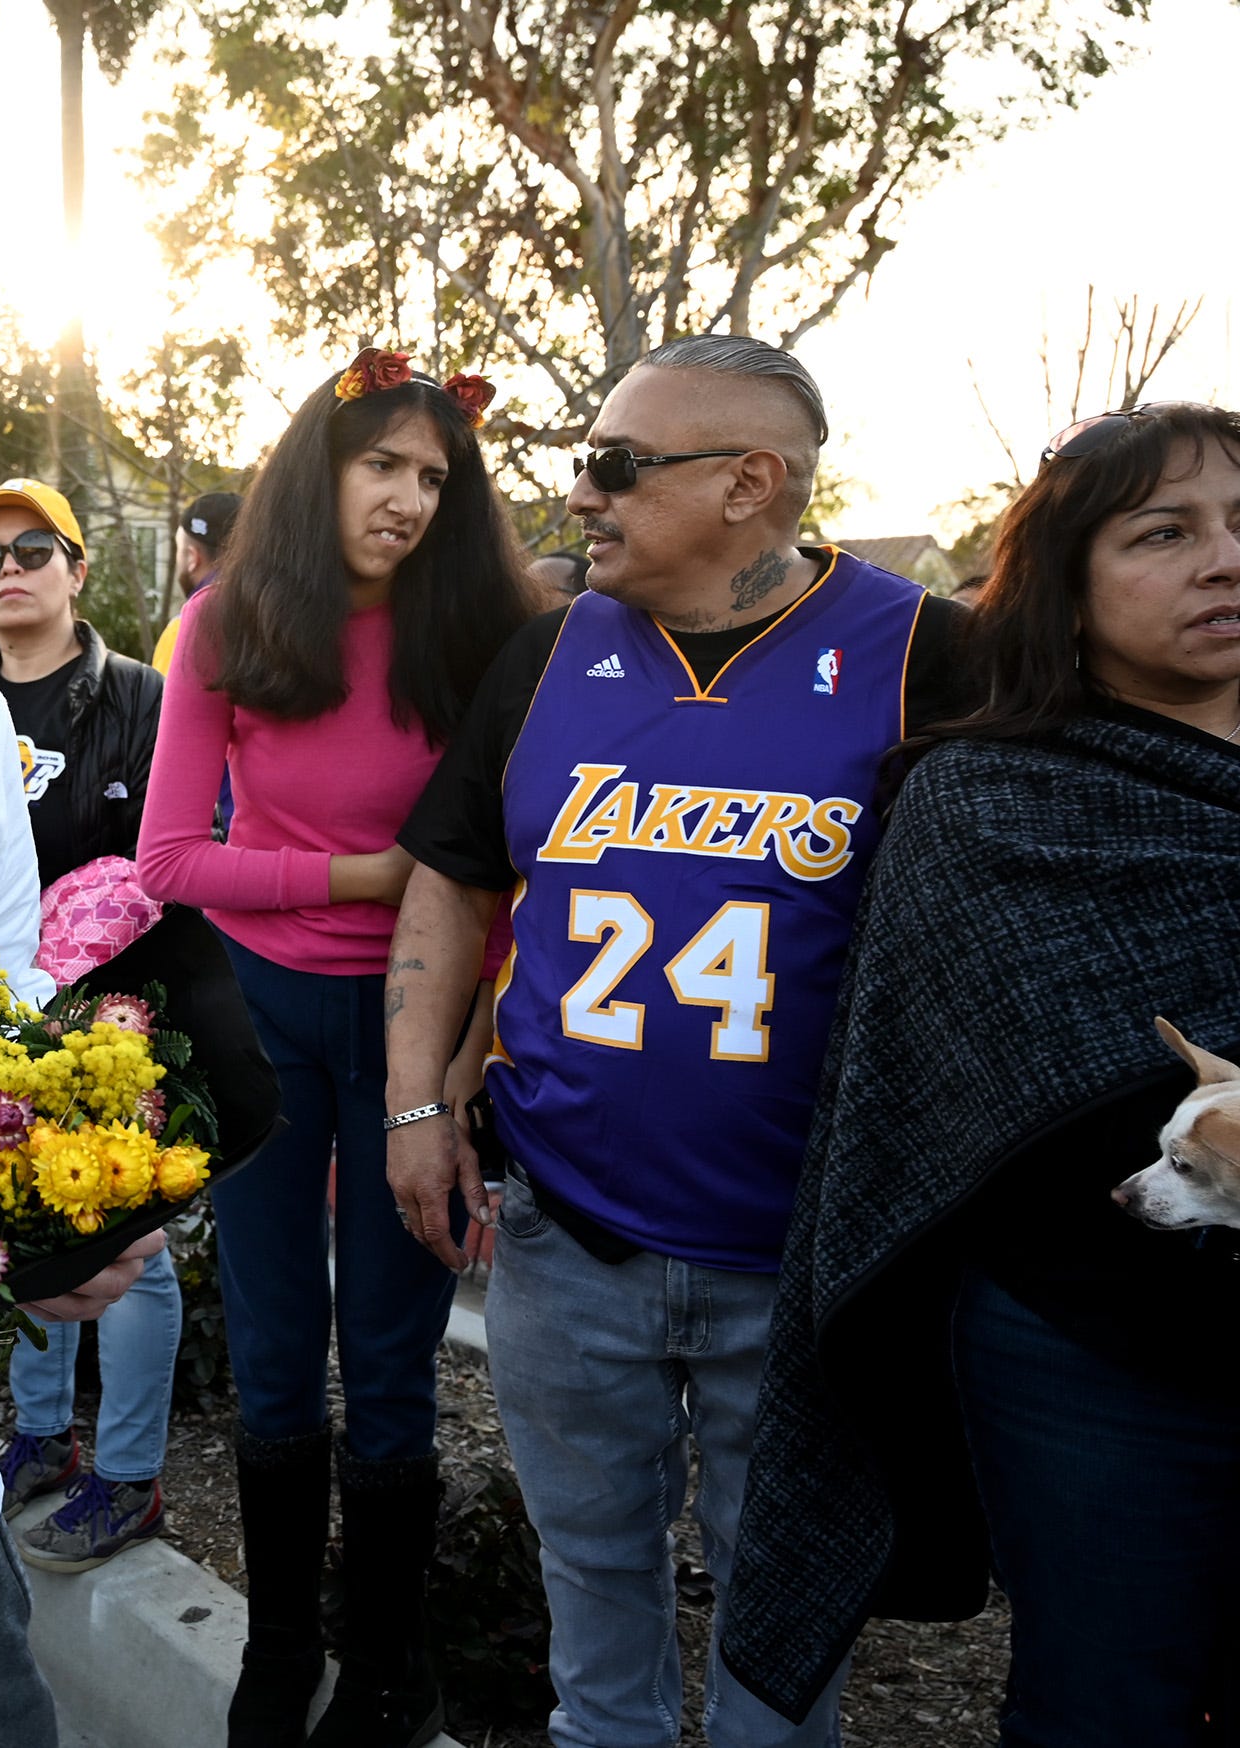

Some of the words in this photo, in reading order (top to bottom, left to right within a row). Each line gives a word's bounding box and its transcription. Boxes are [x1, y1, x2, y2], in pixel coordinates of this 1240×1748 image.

[586, 668, 625, 678] adidas
[813, 683, 830, 692] NBA
[535, 762, 863, 883] LAKERS
[560, 888, 776, 1063] 24
